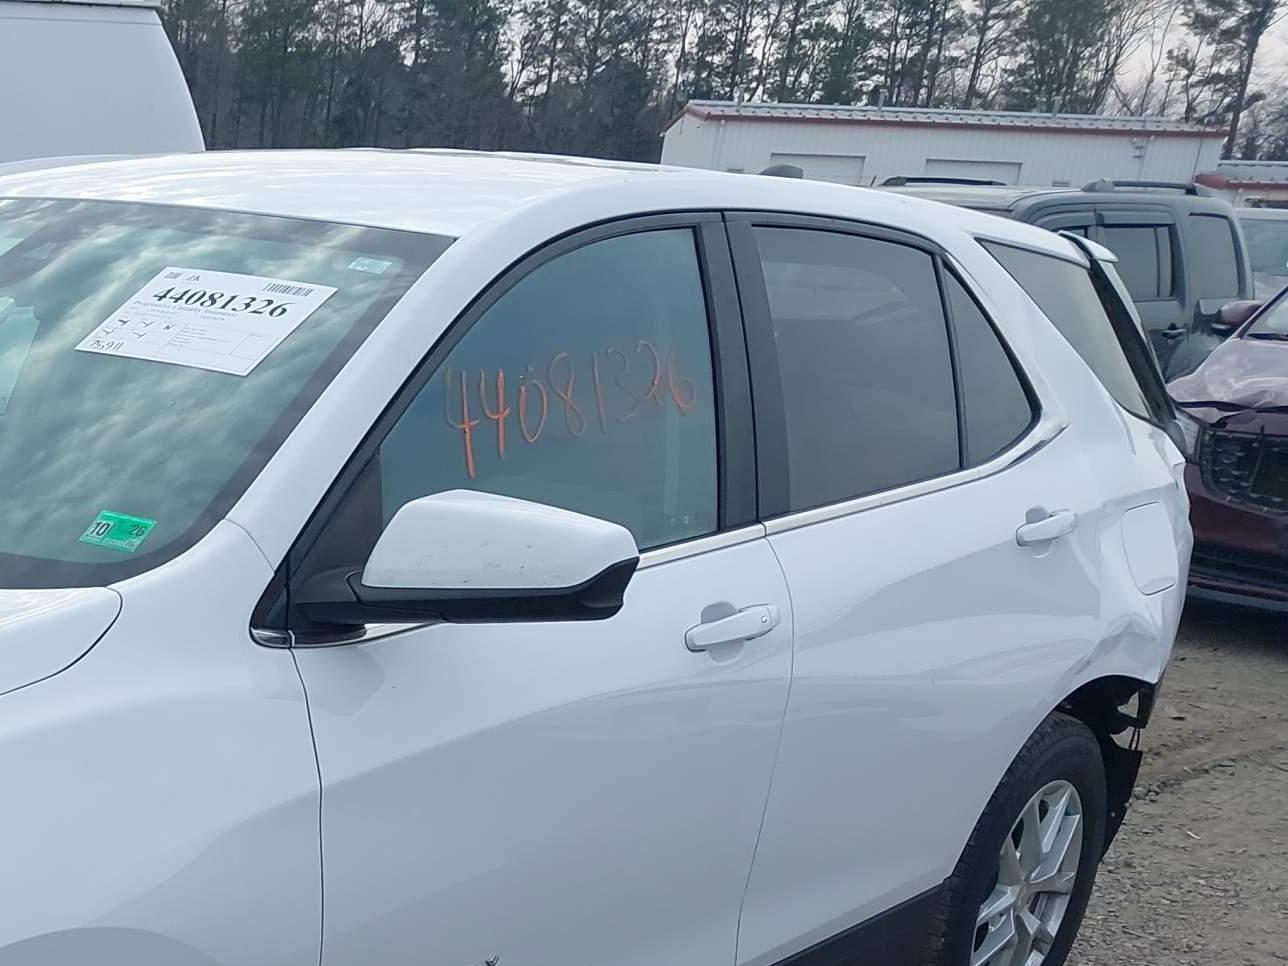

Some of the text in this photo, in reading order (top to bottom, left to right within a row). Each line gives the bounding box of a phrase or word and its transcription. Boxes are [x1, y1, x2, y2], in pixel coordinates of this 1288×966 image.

[152, 286, 296, 318] 44081326
[444, 340, 696, 479] 44081326
[90, 521, 111, 537] 10
